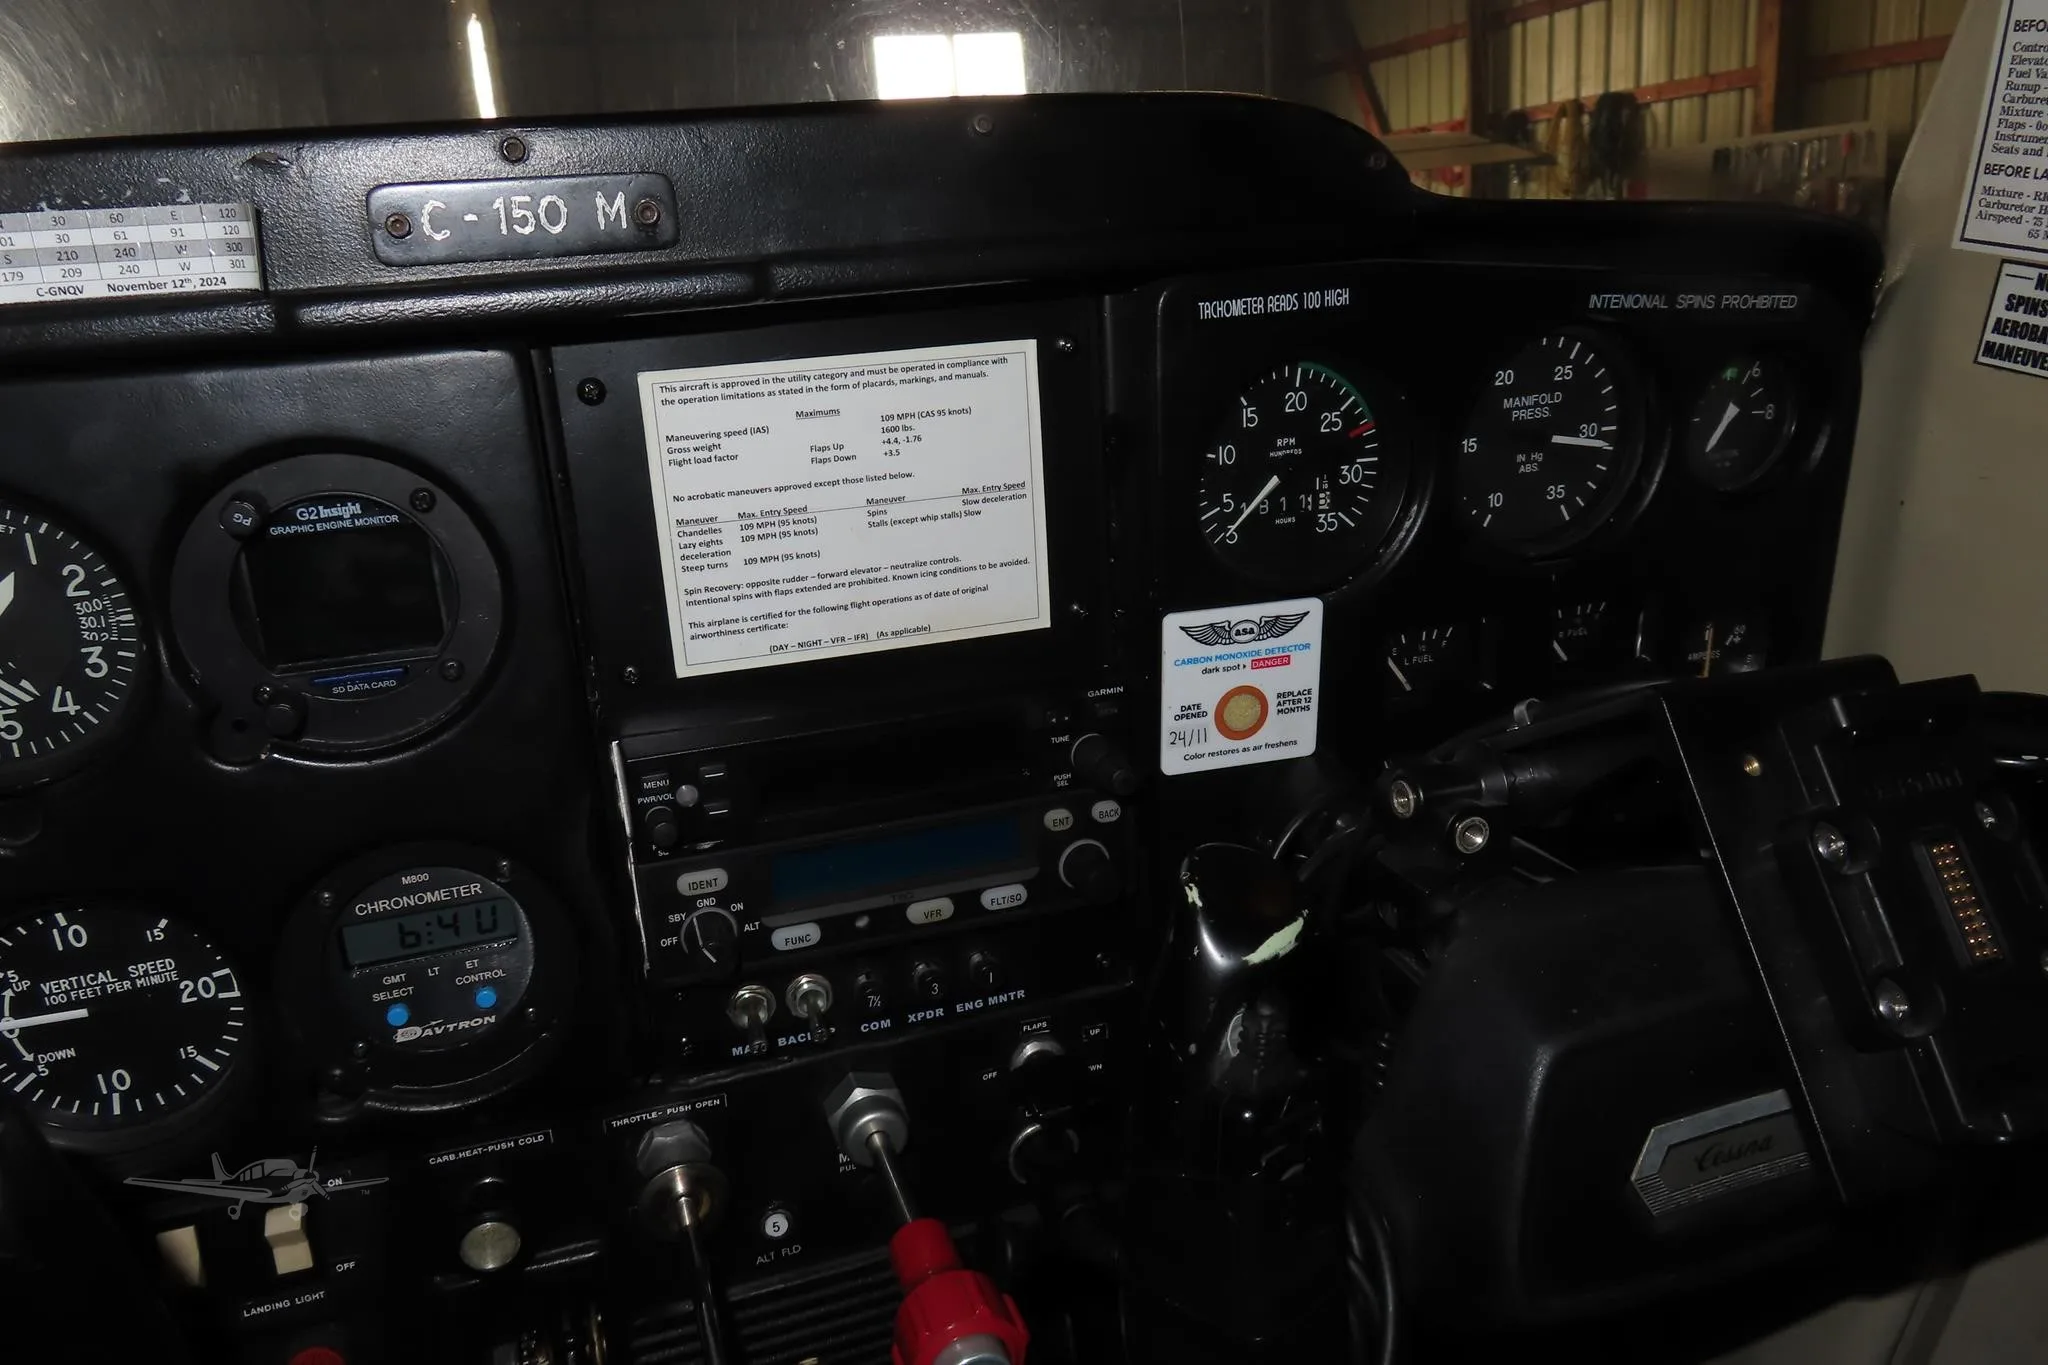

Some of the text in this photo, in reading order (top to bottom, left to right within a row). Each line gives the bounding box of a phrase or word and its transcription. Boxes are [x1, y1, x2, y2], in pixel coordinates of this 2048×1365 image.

[1984, 163, 2031, 179] BEFORE
[1981, 185, 2024, 199] Mixture
[1978, 198, 2036, 214] Carburetor
[421, 203, 451, 242] C
[492, 196, 567, 236] 150
[597, 191, 627, 230] M
[1976, 210, 2023, 224] Airspeed
[56, 225, 240, 244] 30 61 91 120
[56, 242, 243, 261] 210 240 300
[3, 259, 245, 282] 179 209 240 301
[36, 285, 84, 297] C-GNQV
[107, 281, 168, 293] November
[200, 276, 226, 287] 2024
[1198, 288, 1349, 320] TACHOMETER READS 100 HIGH
[1676, 294, 1715, 309] SPINS
[1721, 294, 1798, 309] PROHIBITED
[1495, 369, 1514, 386] 20
[1554, 366, 1573, 380] 25
[1285, 392, 1308, 412] 20
[1503, 391, 1562, 409] MANIFOLD
[795, 408, 840, 418] Maximums
[1242, 407, 1258, 428] 15
[881, 424, 916, 434] 1600 lbs.
[1320, 412, 1342, 432] 25
[665, 425, 769, 443] Maneuvering speed (IAS)
[1579, 422, 1598, 438] 30
[667, 443, 721, 455] Gross weight
[810, 443, 844, 454] Flaps Up
[1277, 437, 1296, 447] RPM
[1462, 438, 1478, 452] 15
[668, 453, 739, 467] Flight load factor
[811, 453, 857, 465] Flaps Down
[1219, 445, 1236, 465] 10
[1339, 464, 1362, 484] 30
[1547, 484, 1565, 499] 35
[1223, 493, 1234, 512] 5
[1488, 492, 1503, 507] 10
[297, 503, 362, 520] G2 Insight
[270, 515, 399, 535] GRAPHIC ENGINE MONITOR
[1316, 512, 1338, 532] 35
[677, 526, 722, 538] Chandelles
[681, 561, 728, 573] Steep turns
[62, 564, 90, 597] 2
[73, 598, 102, 616] 30.0
[690, 622, 789, 641] airworthiness certificate:
[877, 624, 931, 639] (As applicable)
[81, 646, 108, 678] 3
[1174, 643, 1311, 667] CARBON MONOXIDE DETECTOR
[1202, 657, 1288, 675] dark spot DANGER
[332, 680, 396, 694] SD DATA CARD
[1087, 686, 1123, 698] GARMIN
[1277, 688, 1312, 699] REPLACE
[52, 686, 81, 715] 4
[1180, 703, 1202, 712] DATE
[1276, 696, 1312, 707] AFTER 12
[1174, 711, 1208, 721] OPENED
[1277, 705, 1311, 715] MONTHS
[0, 708, 23, 740] 5
[1051, 735, 1070, 744] TUNE
[1183, 752, 1205, 761] Color
[1208, 747, 1240, 757] restores
[1264, 739, 1298, 750] freshens
[643, 779, 669, 789] MENU
[637, 793, 674, 805] PWR/VOL
[1099, 807, 1120, 819] BACK
[1052, 817, 1070, 827] ENT
[402, 873, 429, 885] M800
[688, 878, 718, 891] IDENT
[355, 883, 482, 916] CHRONOMETER
[697, 897, 716, 908] GND
[730, 902, 744, 912] ON
[990, 893, 1022, 906] FLT/SQ
[668, 912, 686, 923] SBY
[923, 908, 942, 919] VFR
[146, 928, 165, 942] 15
[744, 922, 760, 933] ALT
[53, 924, 88, 950] 10
[660, 936, 678, 947] OFF
[785, 934, 812, 946] FUNC
[41, 958, 175, 995] VERTICAL SPEED
[383, 959, 479, 985] GMT LT ET
[456, 968, 506, 985] CONTROL
[44, 971, 179, 1006] 100 FEET PER MINUTE
[179, 977, 215, 1003] 20
[373, 987, 414, 1002] SELECT
[956, 989, 1026, 1013] ENG MNTR
[908, 1008, 944, 1023] XPDR
[860, 1019, 891, 1033] COM
[1023, 1021, 1048, 1032] FLAPS
[38, 1048, 76, 1064] DOWN
[180, 1046, 197, 1059] 15
[97, 1069, 131, 1094] 10
[667, 1104, 691, 1115] PUSH
[696, 1099, 720, 1108] OPEN
[518, 1133, 545, 1148] COLD
[756, 1244, 802, 1266] ALT FLD
[243, 1290, 326, 1319] LANDING LIGHT
